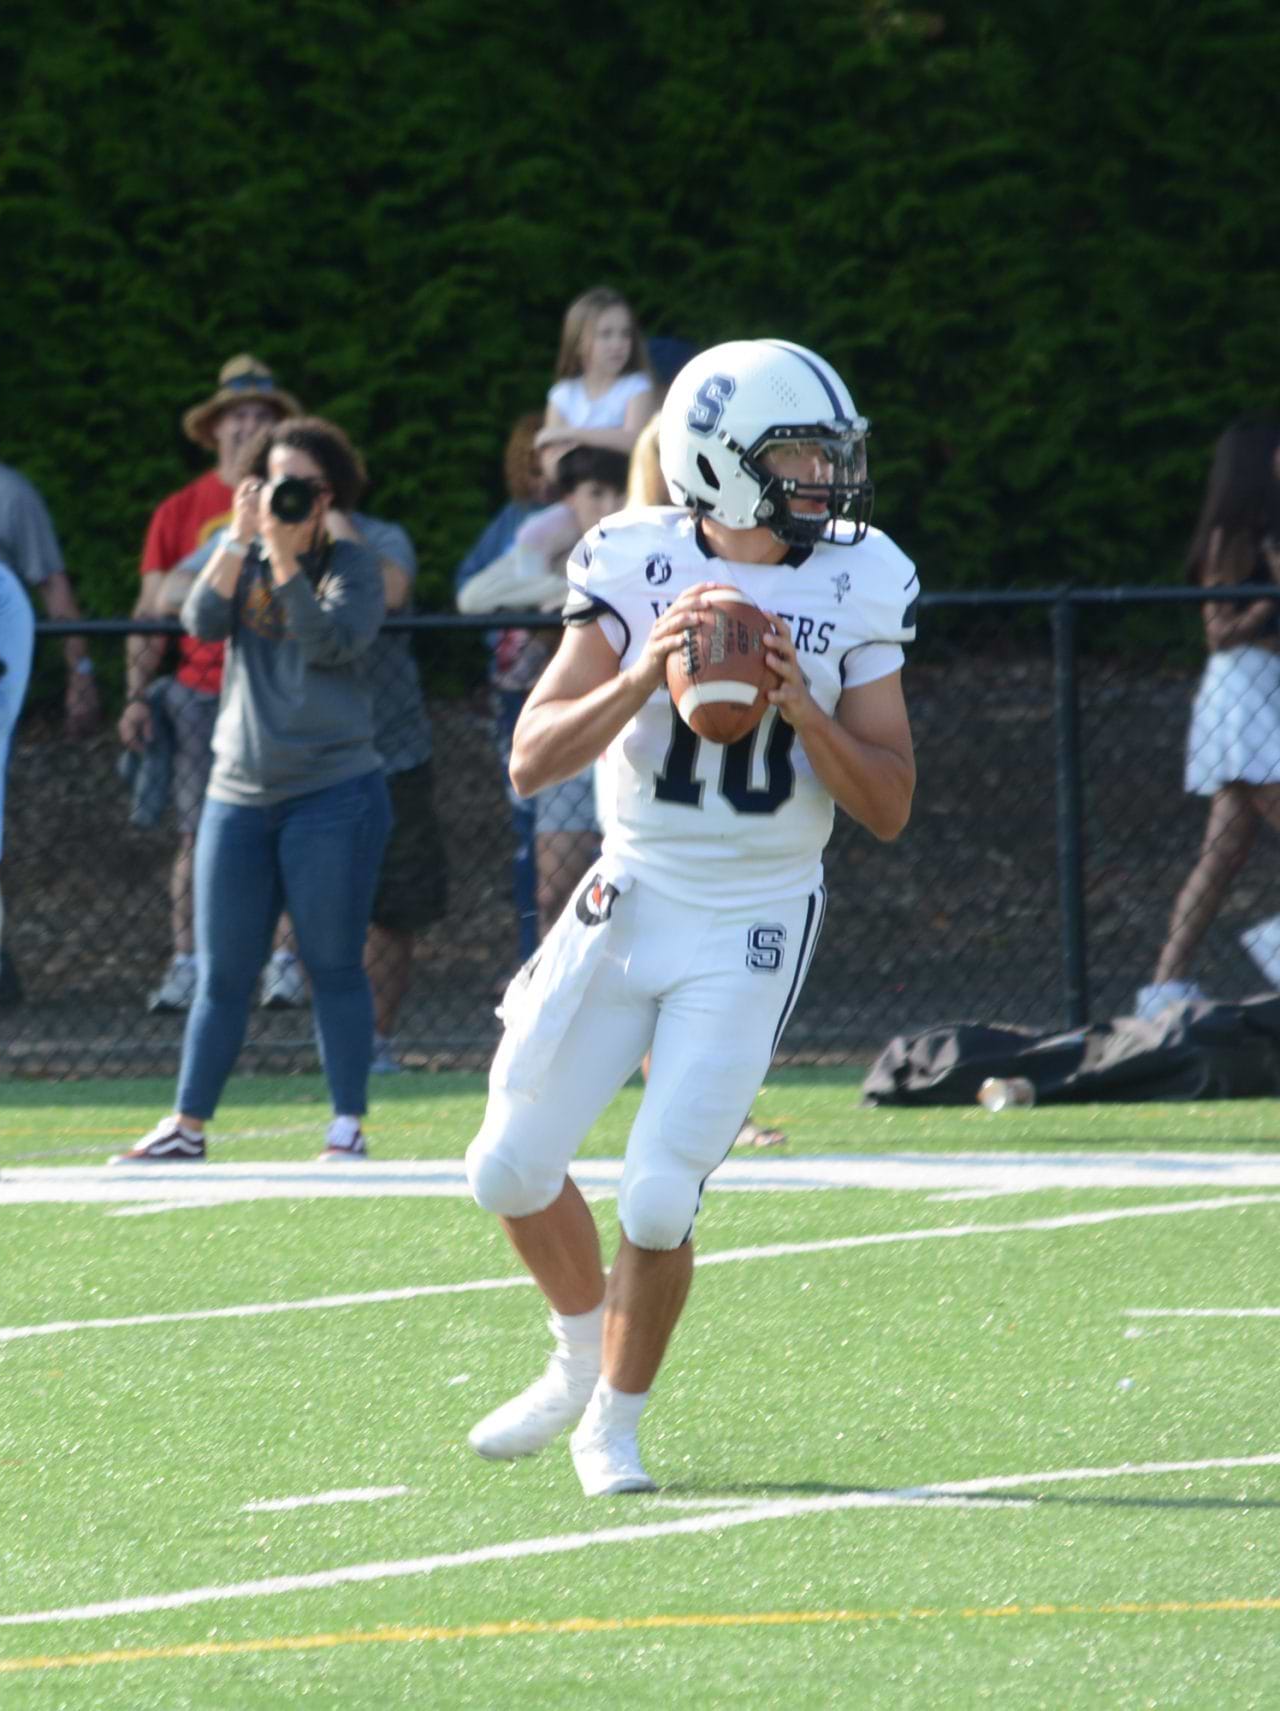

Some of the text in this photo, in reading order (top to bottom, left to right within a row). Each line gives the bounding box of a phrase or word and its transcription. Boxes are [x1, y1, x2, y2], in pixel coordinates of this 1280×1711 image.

[686, 373, 736, 439] S
[654, 681, 802, 817] 10
[746, 922, 786, 975] S
